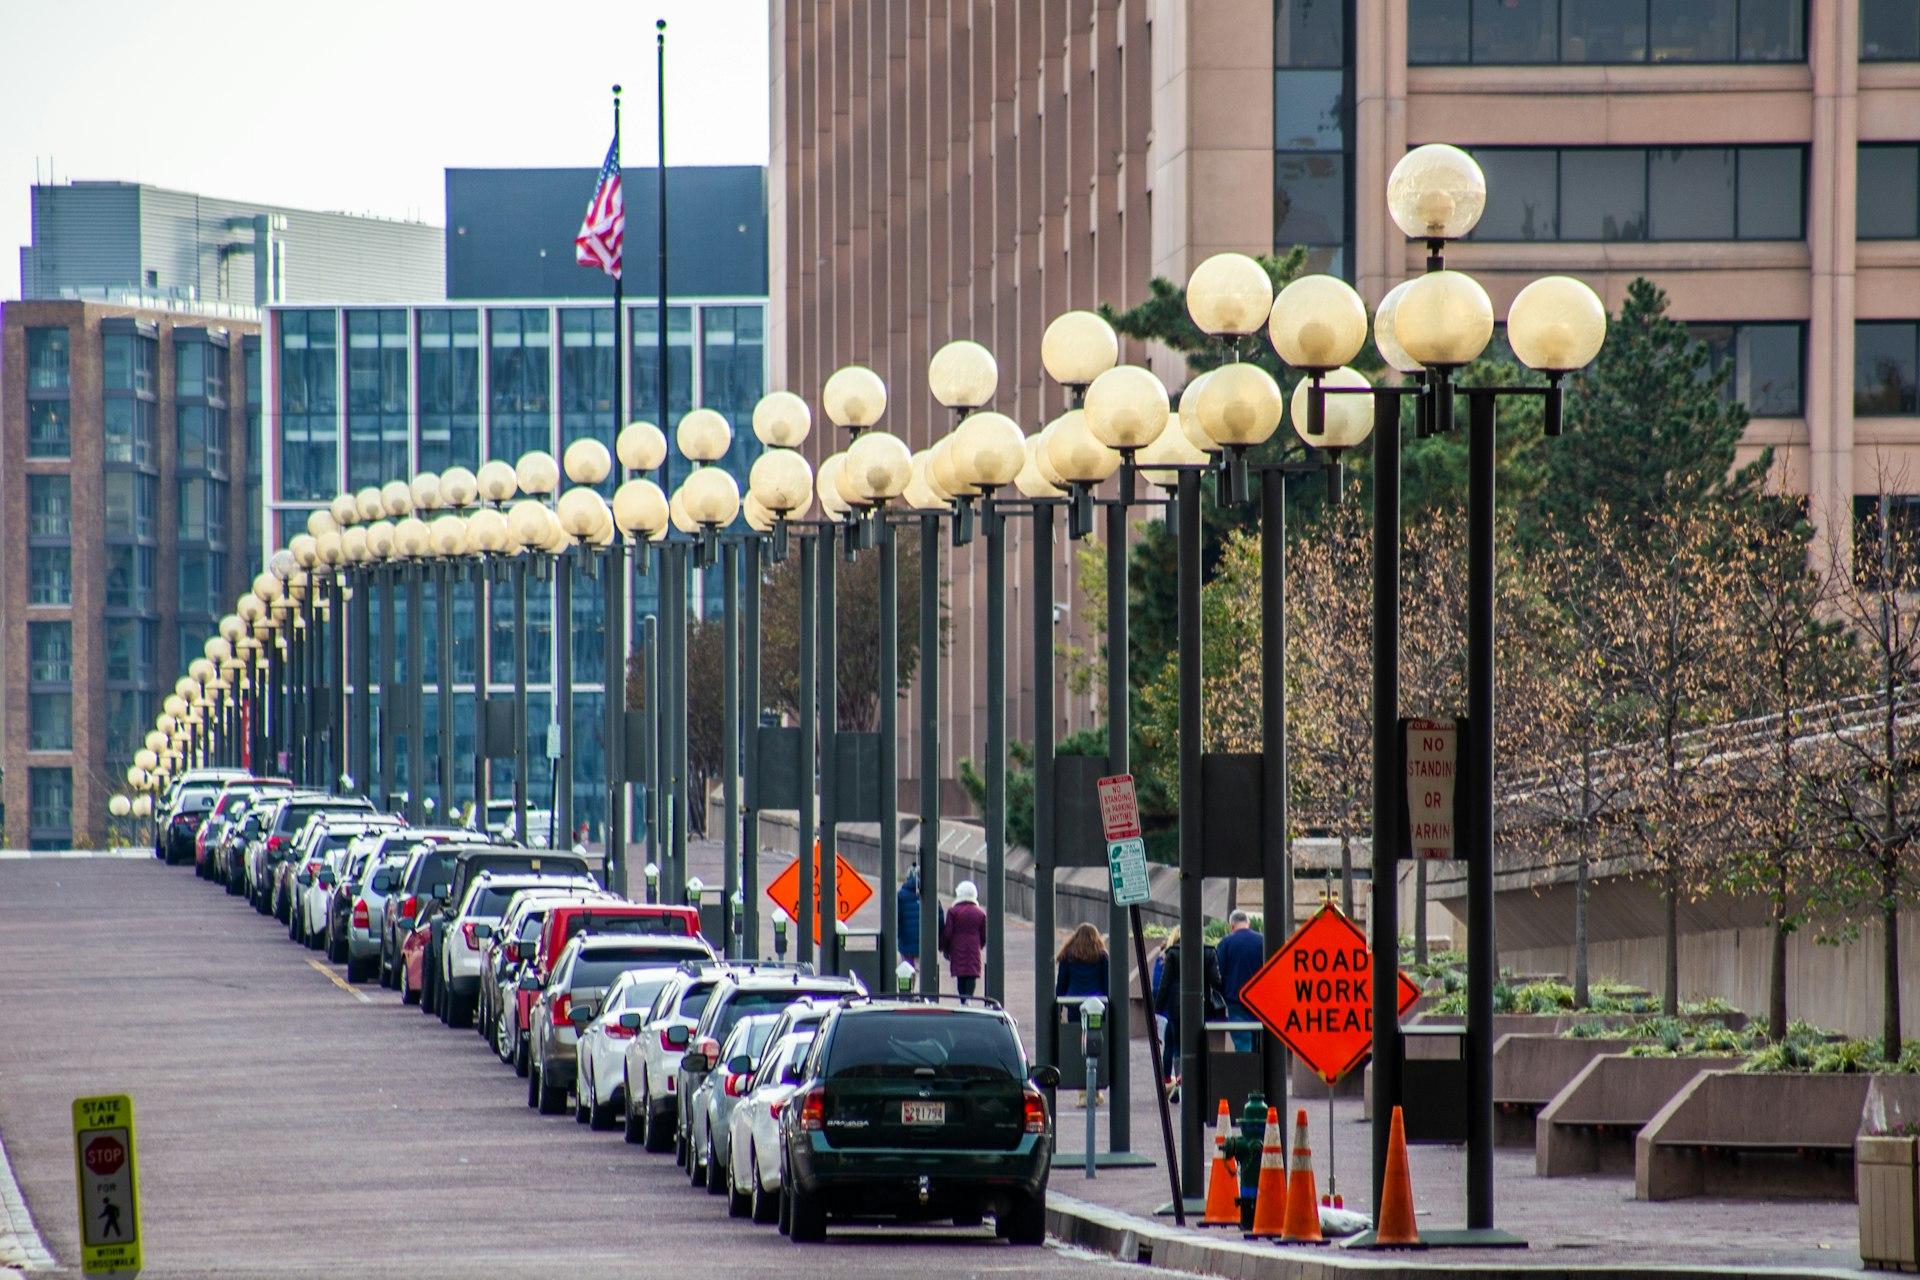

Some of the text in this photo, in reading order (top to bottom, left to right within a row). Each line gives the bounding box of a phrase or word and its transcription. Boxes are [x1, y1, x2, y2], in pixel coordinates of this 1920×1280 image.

[1423, 738, 1444, 751] NO
[1112, 785, 1121, 794] NO
[1104, 793, 1132, 805] STANDING
[1424, 792, 1441, 808] OR
[1112, 802, 1134, 813] PARKING
[1411, 823, 1453, 840] ARKIN
[1294, 949, 1369, 972] ROAD
[1294, 979, 1369, 1003] WORK
[83, 1100, 120, 1114] STATE
[89, 1113, 115, 1126] LAW
[88, 1150, 122, 1164] STOP
[97, 1184, 117, 1193] FOR
[97, 1247, 125, 1257] WITHIN
